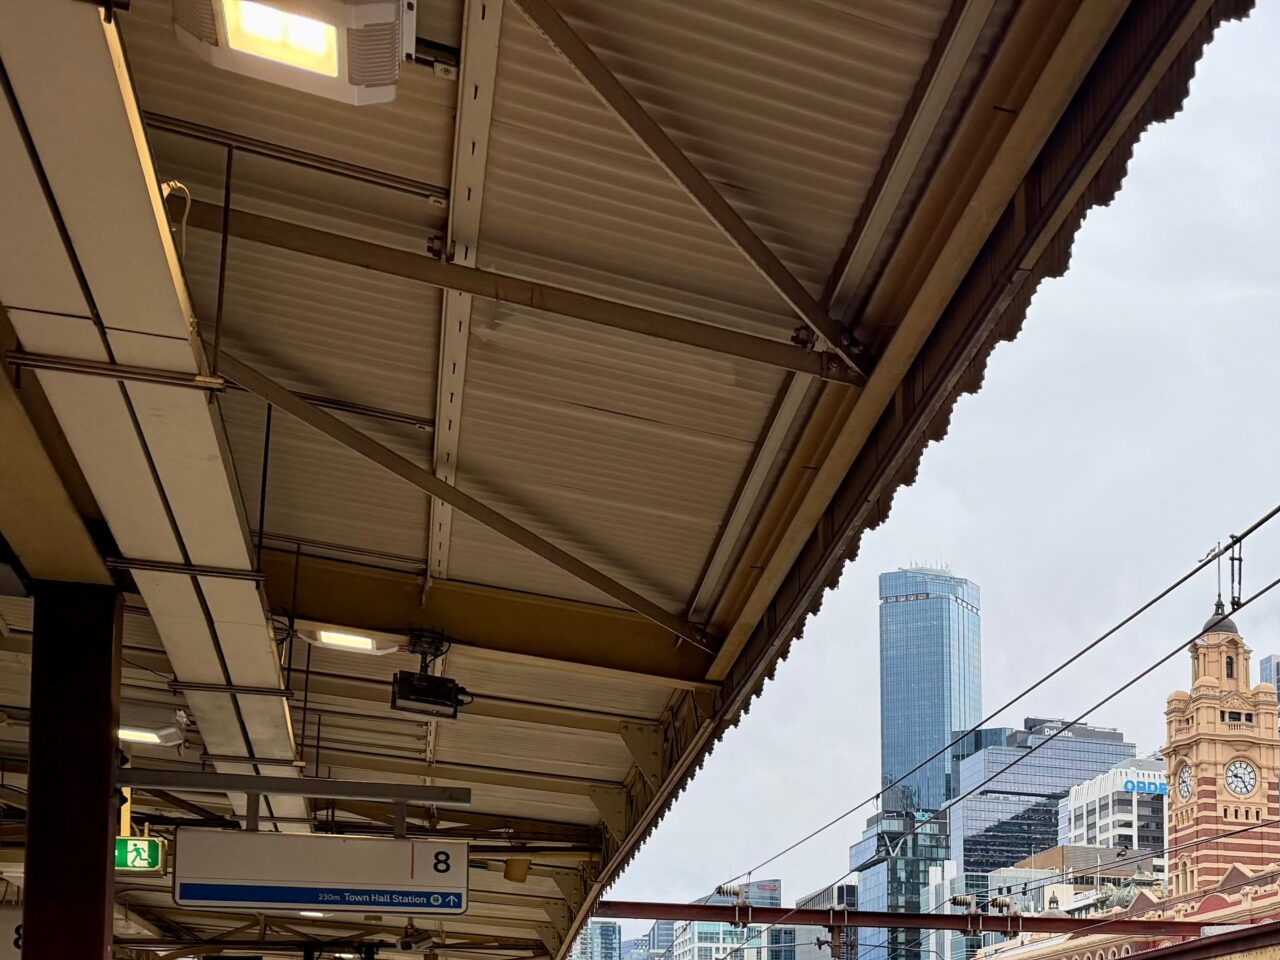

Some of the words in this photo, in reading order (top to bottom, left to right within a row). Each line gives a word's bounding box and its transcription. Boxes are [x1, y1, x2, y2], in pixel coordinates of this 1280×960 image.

[433, 850, 451, 874] 8
[318, 893, 341, 902] 230m
[344, 892, 370, 903] Town
[371, 893, 390, 903] Hall
[392, 894, 427, 905] Station
